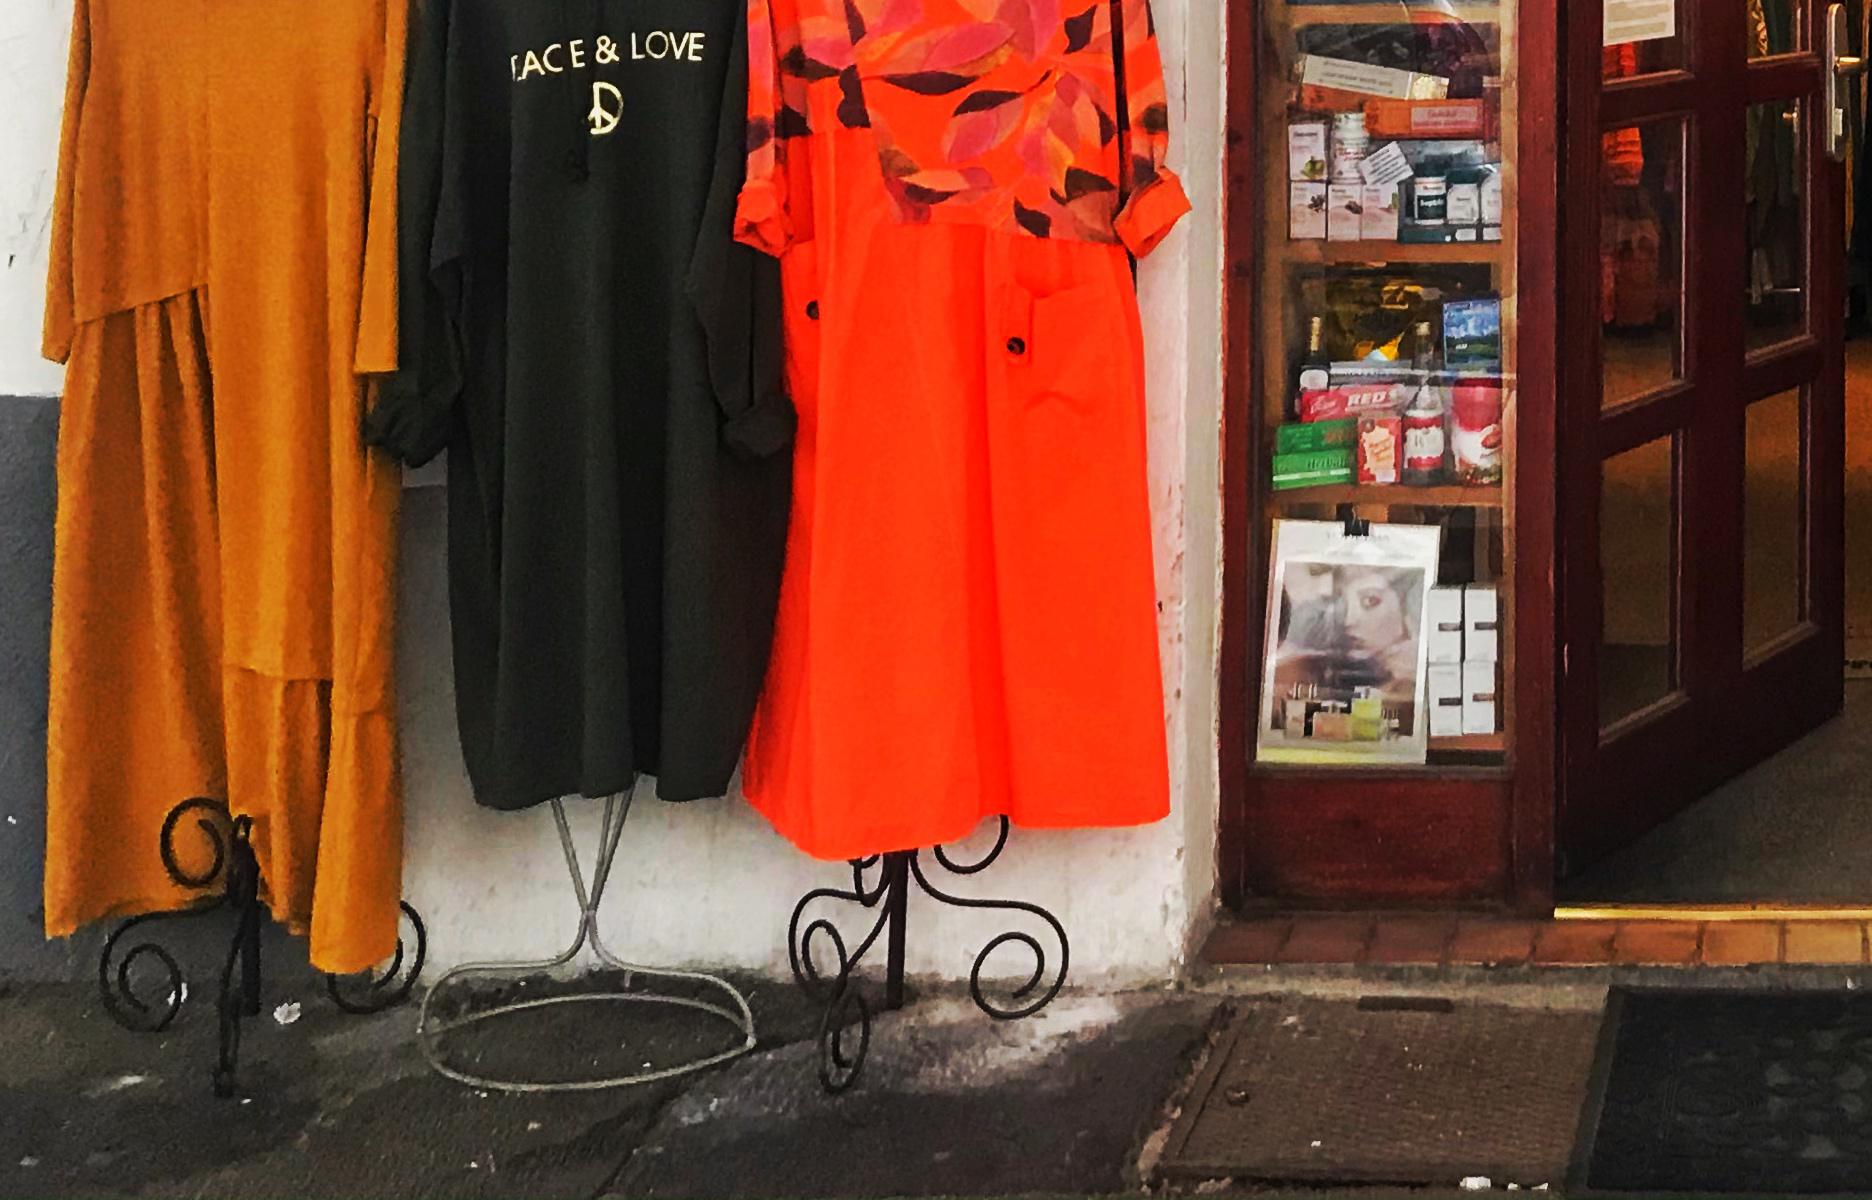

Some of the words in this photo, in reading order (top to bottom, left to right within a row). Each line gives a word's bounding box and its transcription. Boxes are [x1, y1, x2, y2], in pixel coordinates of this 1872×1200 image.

[595, 34, 620, 65] &
[631, 30, 706, 62] LOVE
[1347, 390, 1388, 407] RED
